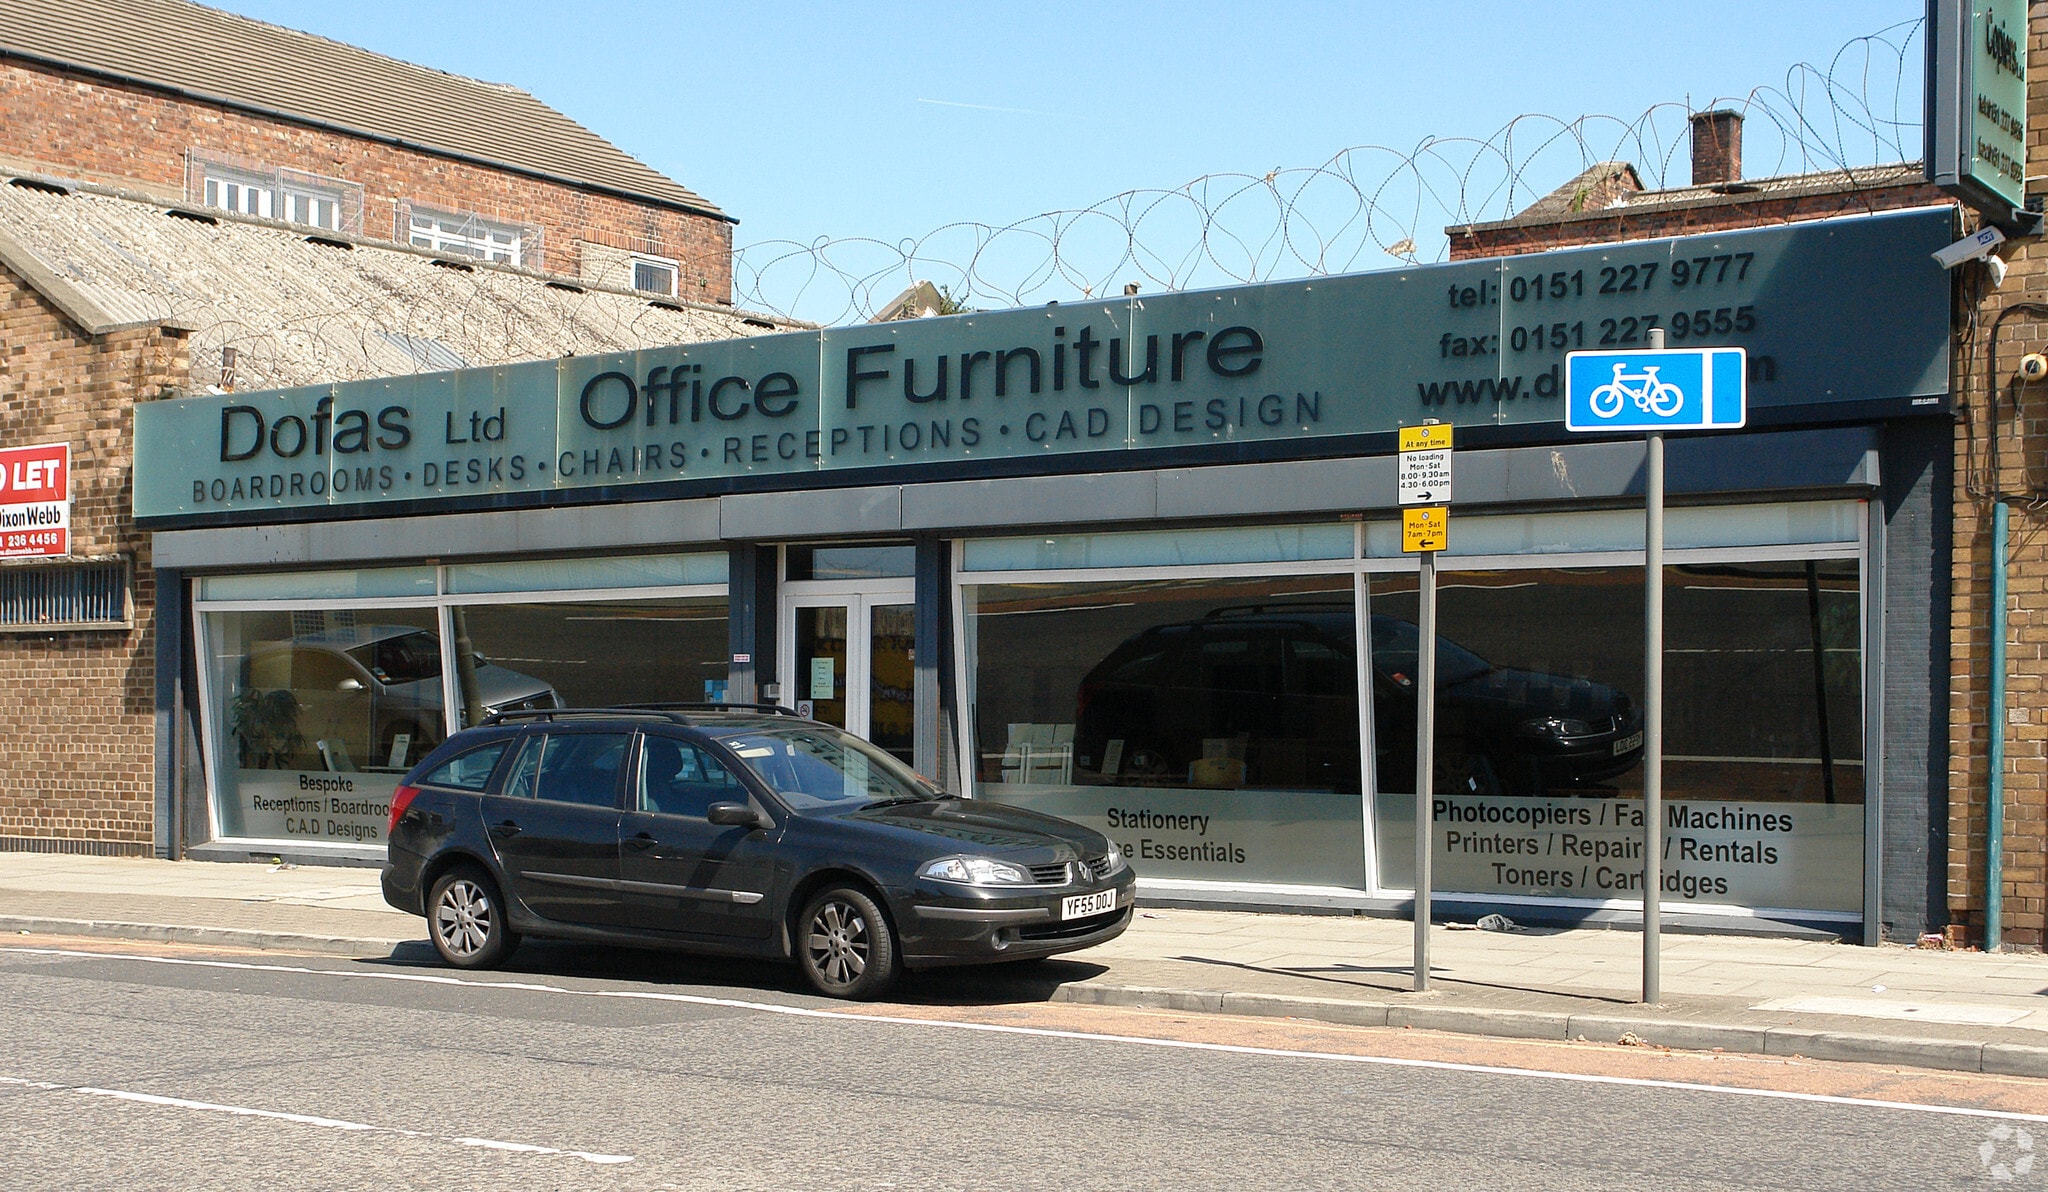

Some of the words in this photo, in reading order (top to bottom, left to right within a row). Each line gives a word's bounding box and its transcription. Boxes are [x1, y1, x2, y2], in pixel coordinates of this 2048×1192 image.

[1448, 279, 1498, 309] tel:
[1510, 269, 1584, 301] 0151
[1599, 262, 1660, 295] 227
[1670, 251, 1755, 288] 9777
[1439, 332, 1498, 359] fax:
[1510, 321, 1585, 352] 0151
[1599, 314, 1660, 346] 227
[1670, 305, 1756, 341] 9555
[220, 396, 412, 463] Dofas
[445, 406, 506, 445] Ltd
[579, 363, 799, 431] Office
[846, 325, 1264, 409] Furniture
[193, 465, 394, 503] BOARDROOMS
[423, 455, 526, 487] DESKS
[558, 441, 686, 477] CHAIRS
[723, 417, 981, 464] RECEPTIONS
[1025, 407, 1108, 442] CAD
[1139, 391, 1320, 435] DESIGN
[1405, 440, 1414, 448] At
[1415, 441, 1428, 449] any
[1430, 439, 1446, 447] time
[1418, 453, 1444, 462] loading
[12, 459, 60, 491] LET
[8, 534, 27, 547] 236
[28, 532, 58, 546] 4456
[299, 774, 353, 795] Bespoke
[253, 795, 321, 815] Receptions
[331, 798, 390, 817] Boardroo
[1432, 799, 1592, 830] Photocopiers
[1614, 803, 1645, 827] Fa
[1668, 804, 1793, 833] Machines
[286, 817, 320, 835] C.A.D
[327, 819, 378, 842] Designs
[1107, 807, 1210, 836] Stationery
[1140, 838, 1246, 864] Essentials
[1446, 830, 1539, 855] Printers
[1561, 832, 1643, 863] Repair
[1679, 837, 1779, 865] Rentals
[1491, 862, 1573, 888] Toners
[1595, 866, 1729, 899] Cartidges
[1067, 896, 1094, 916] YF55
[1095, 891, 1113, 911] DOJ
